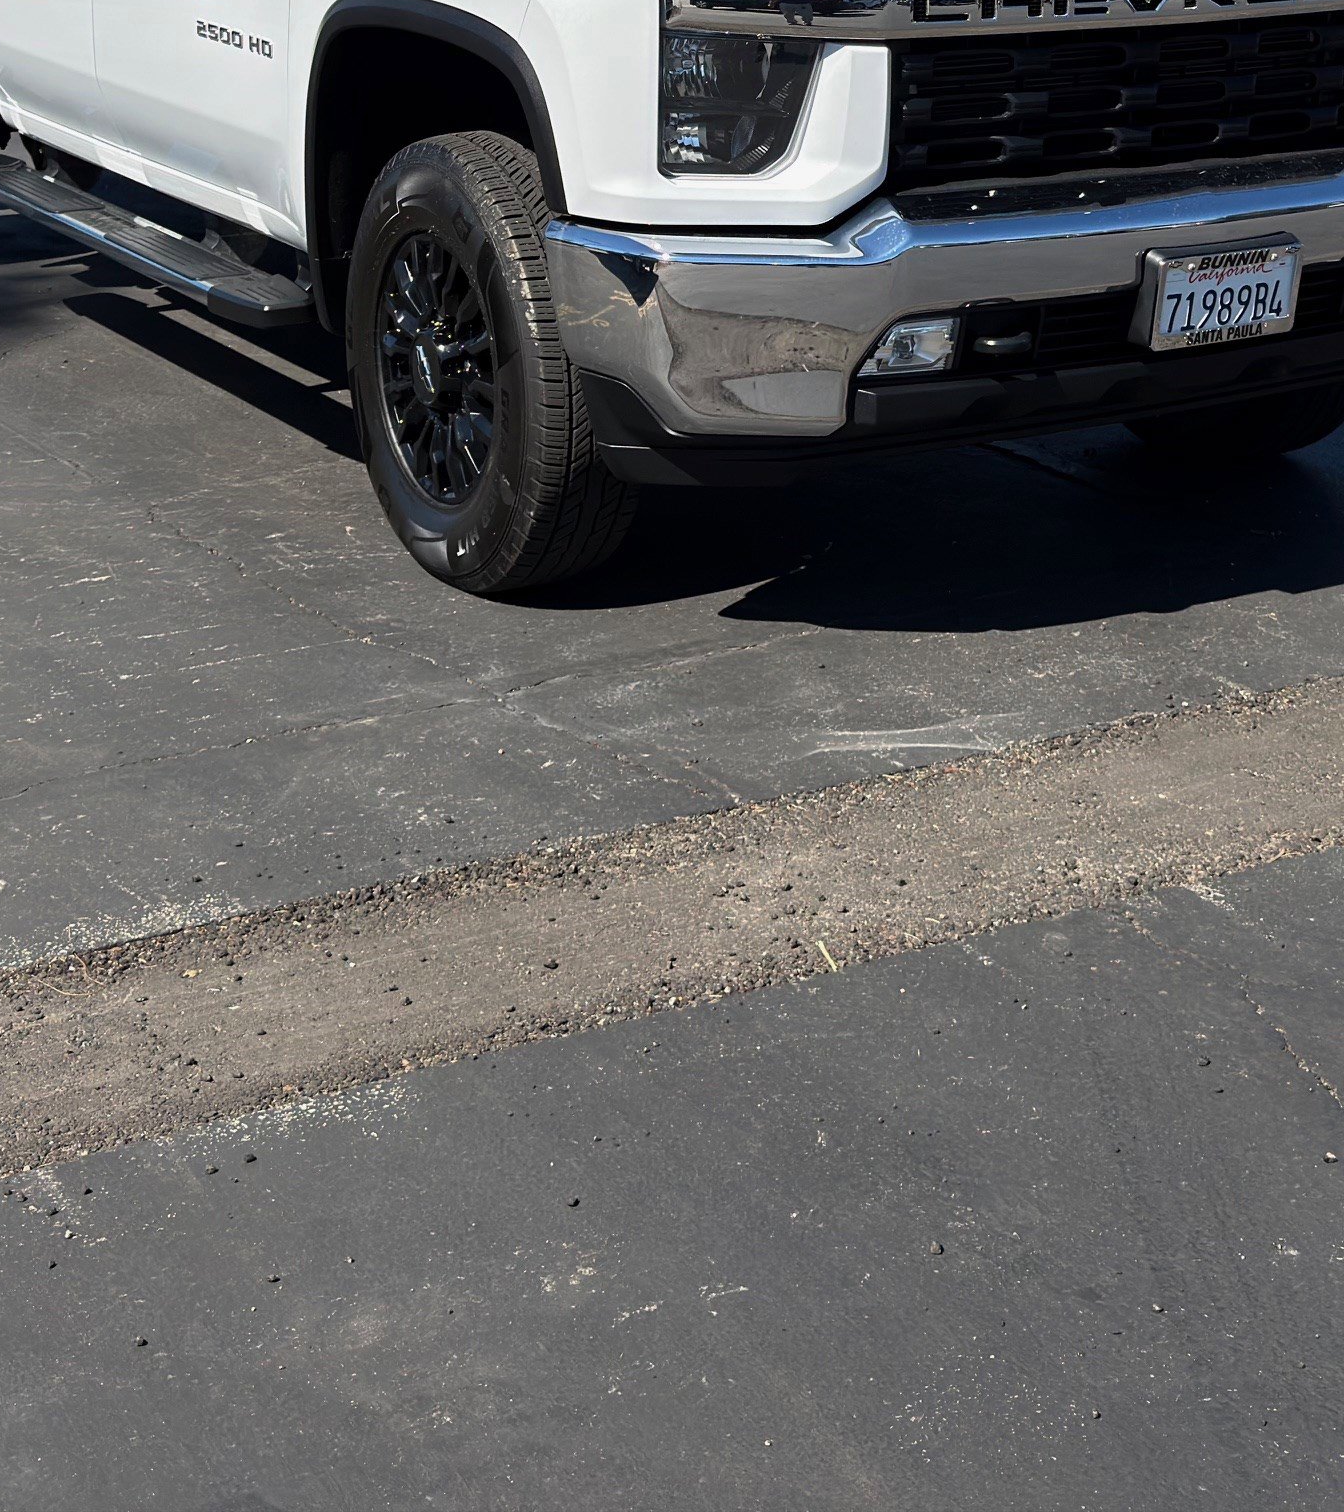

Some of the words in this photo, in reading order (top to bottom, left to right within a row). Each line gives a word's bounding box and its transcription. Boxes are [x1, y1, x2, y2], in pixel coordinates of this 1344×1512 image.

[196, 19, 244, 50] 2500
[248, 34, 274, 60] HD
[1197, 249, 1271, 271] BUNNIN
[1188, 262, 1272, 286] California
[1166, 280, 1283, 334] 71989B4
[1186, 327, 1223, 346] SANTA
[1227, 323, 1263, 340] PAULA
